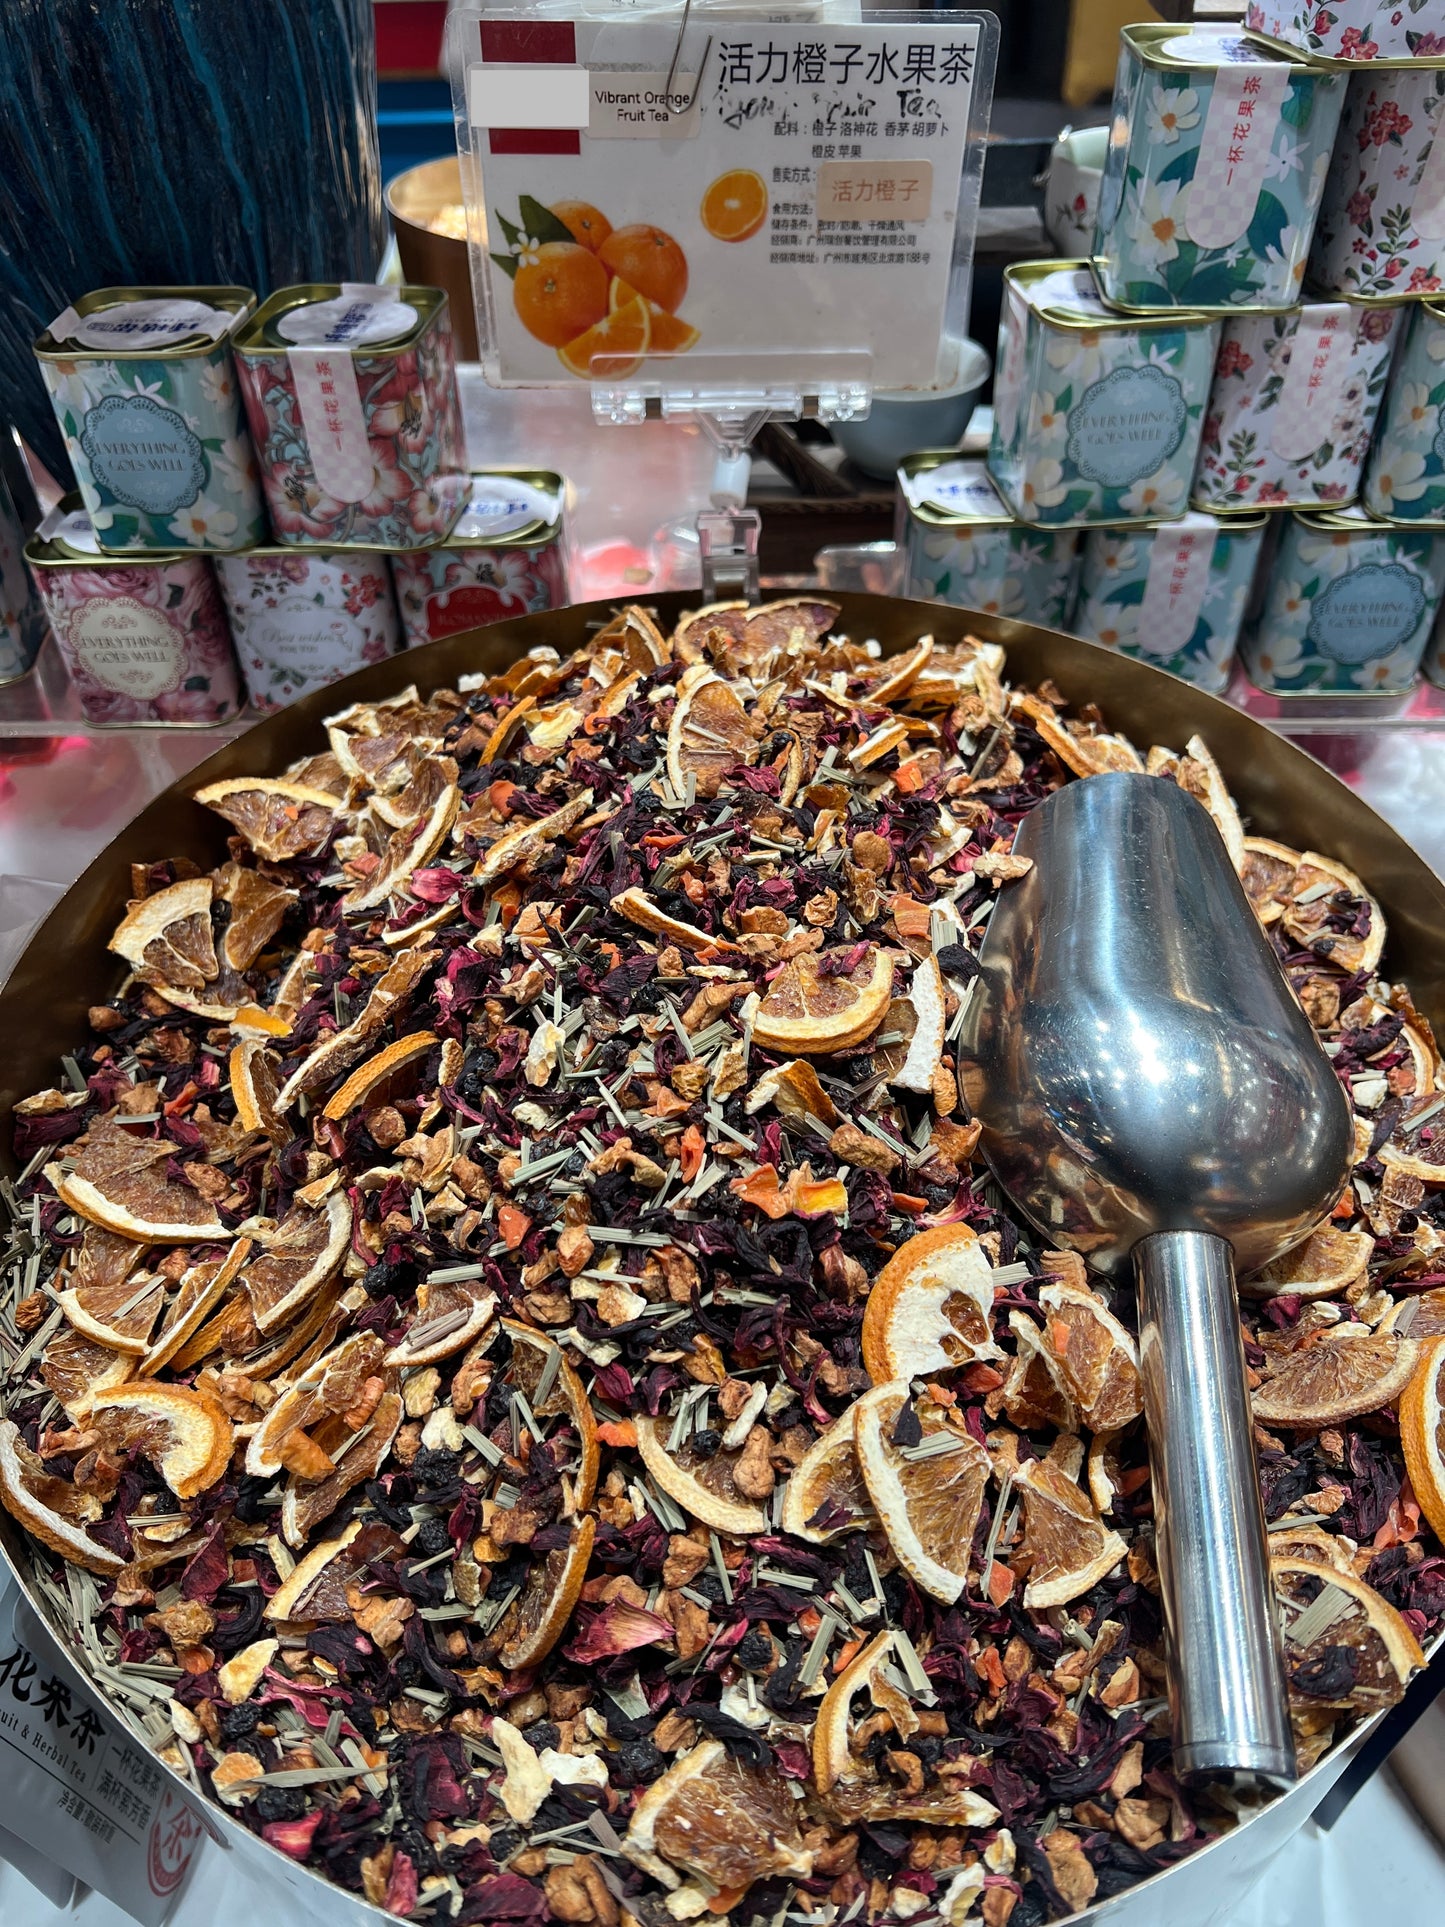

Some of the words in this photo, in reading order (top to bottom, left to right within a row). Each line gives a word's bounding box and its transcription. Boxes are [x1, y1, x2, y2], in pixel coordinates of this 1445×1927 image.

[718, 41, 975, 86] 活力橙子水果茶
[595, 90, 641, 104] Vibrant
[644, 91, 690, 107] Orange
[617, 108, 646, 122] Fruit
[648, 108, 669, 122] Tea
[840, 121, 878, 137] 洛神花
[884, 121, 910, 137] 香茅
[912, 121, 949, 137] 胡萝卜
[1226, 75, 1262, 186] 一杯花果茶
[811, 144, 835, 159] 橙皮
[838, 144, 862, 158] 苹果
[831, 179, 920, 202] 活力橙子
[95, 442, 187, 456] EVERYTHING
[81, 635, 169, 649] EVERYTHING
[20, 1724, 31, 1740] &
[32, 1732, 69, 1769] Herbal
[69, 1760, 87, 1784] Tea
